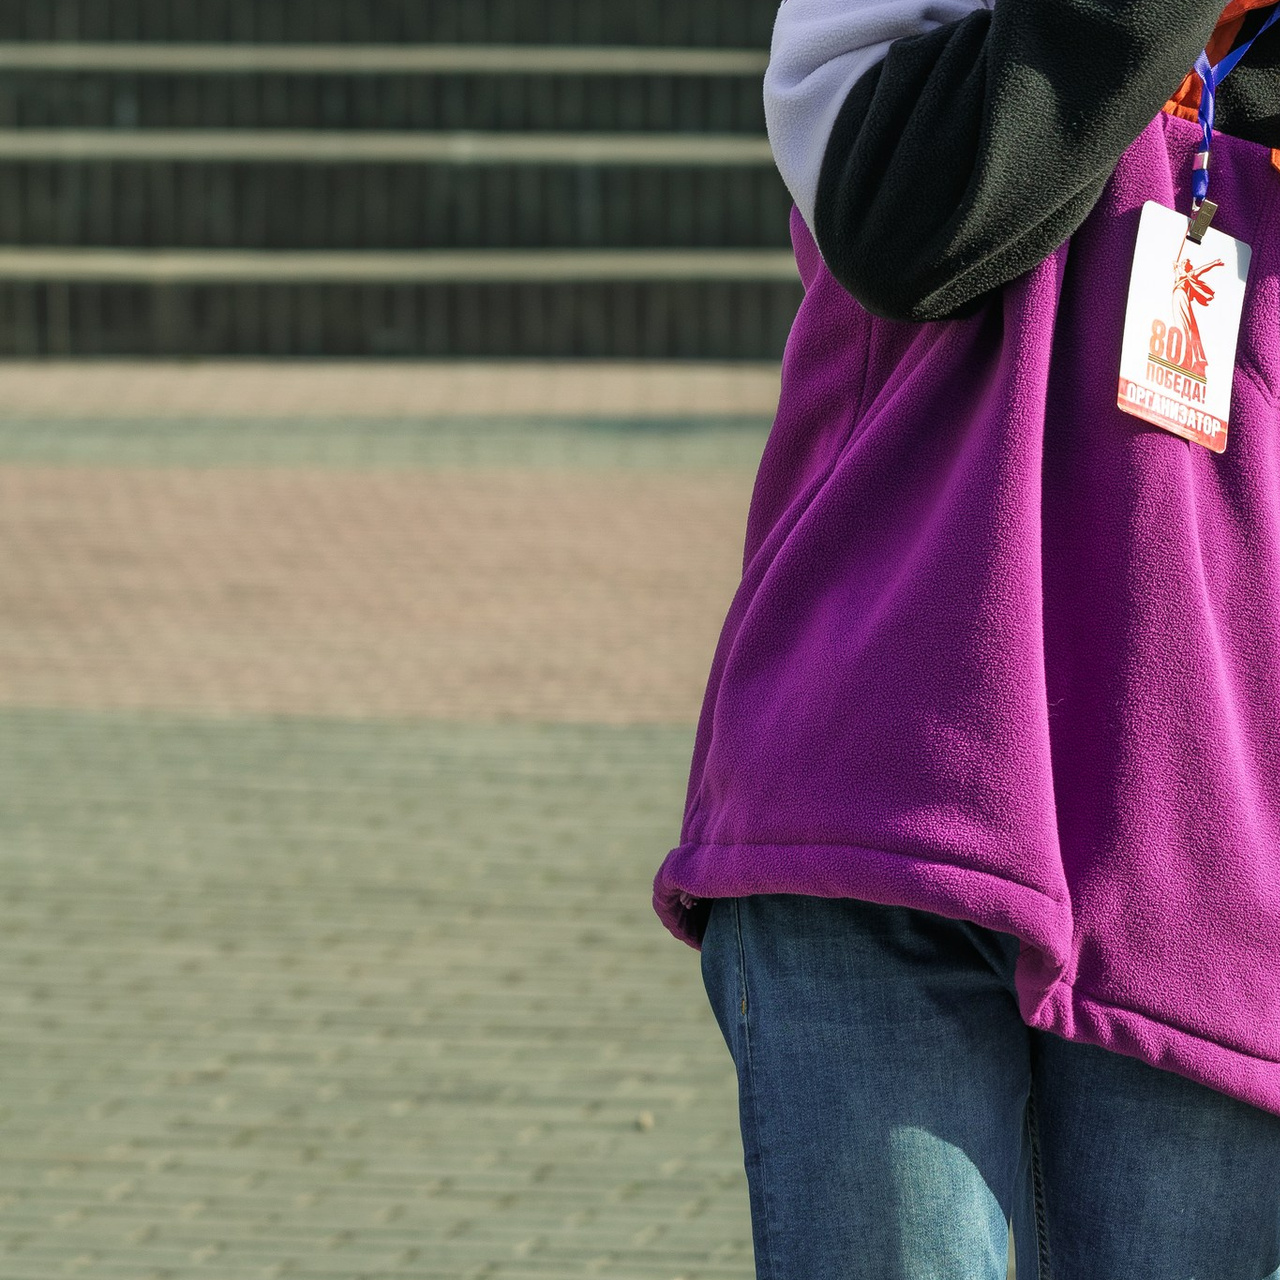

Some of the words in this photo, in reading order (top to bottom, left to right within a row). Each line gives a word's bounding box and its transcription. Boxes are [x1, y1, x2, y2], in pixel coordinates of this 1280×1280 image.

[1149, 319, 1182, 364] 80
[1146, 362, 1206, 404] ПОБЕДА!
[1128, 382, 1221, 437] ОРГАНИЗАТОР
